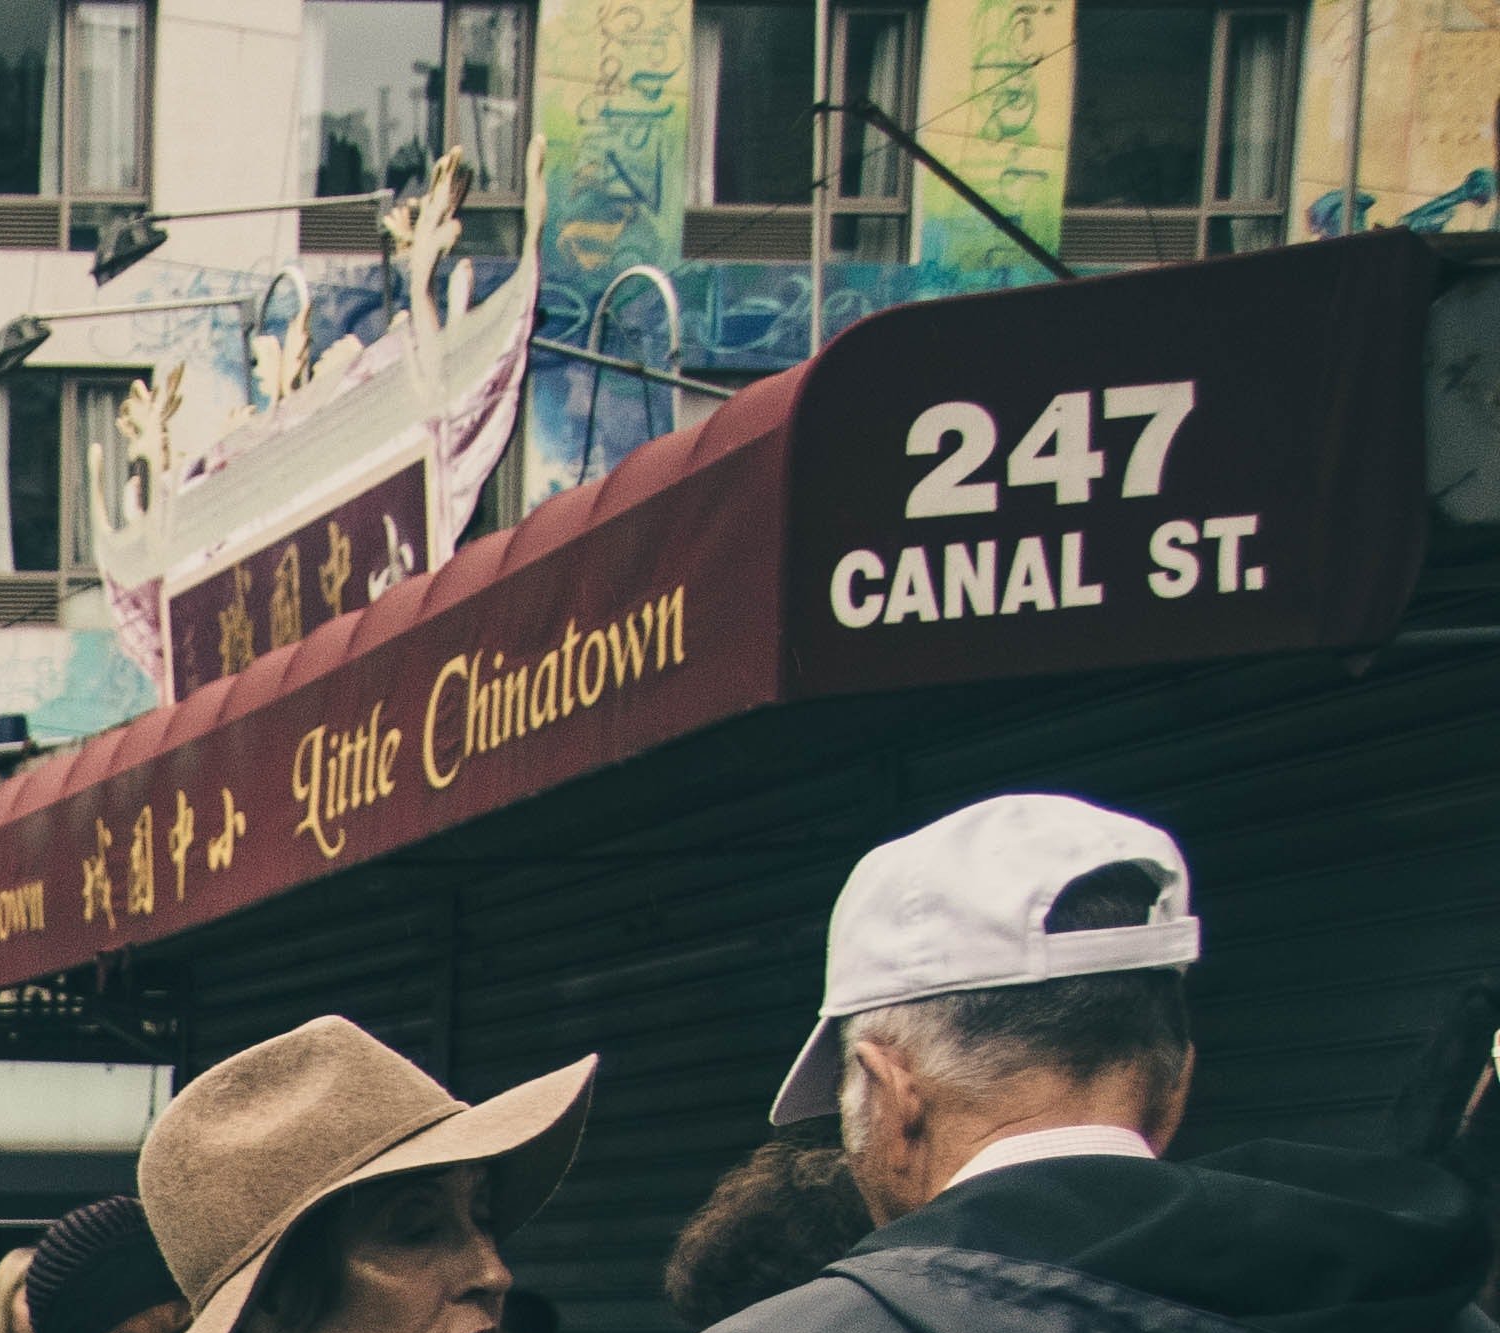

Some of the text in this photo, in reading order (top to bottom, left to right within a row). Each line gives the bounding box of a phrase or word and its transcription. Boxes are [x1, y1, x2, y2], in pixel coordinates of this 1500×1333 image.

[905, 379, 1197, 519] 247
[830, 515, 1266, 628] CANAL ST.
[292, 701, 402, 859] Little
[424, 585, 685, 790] Chinatown
